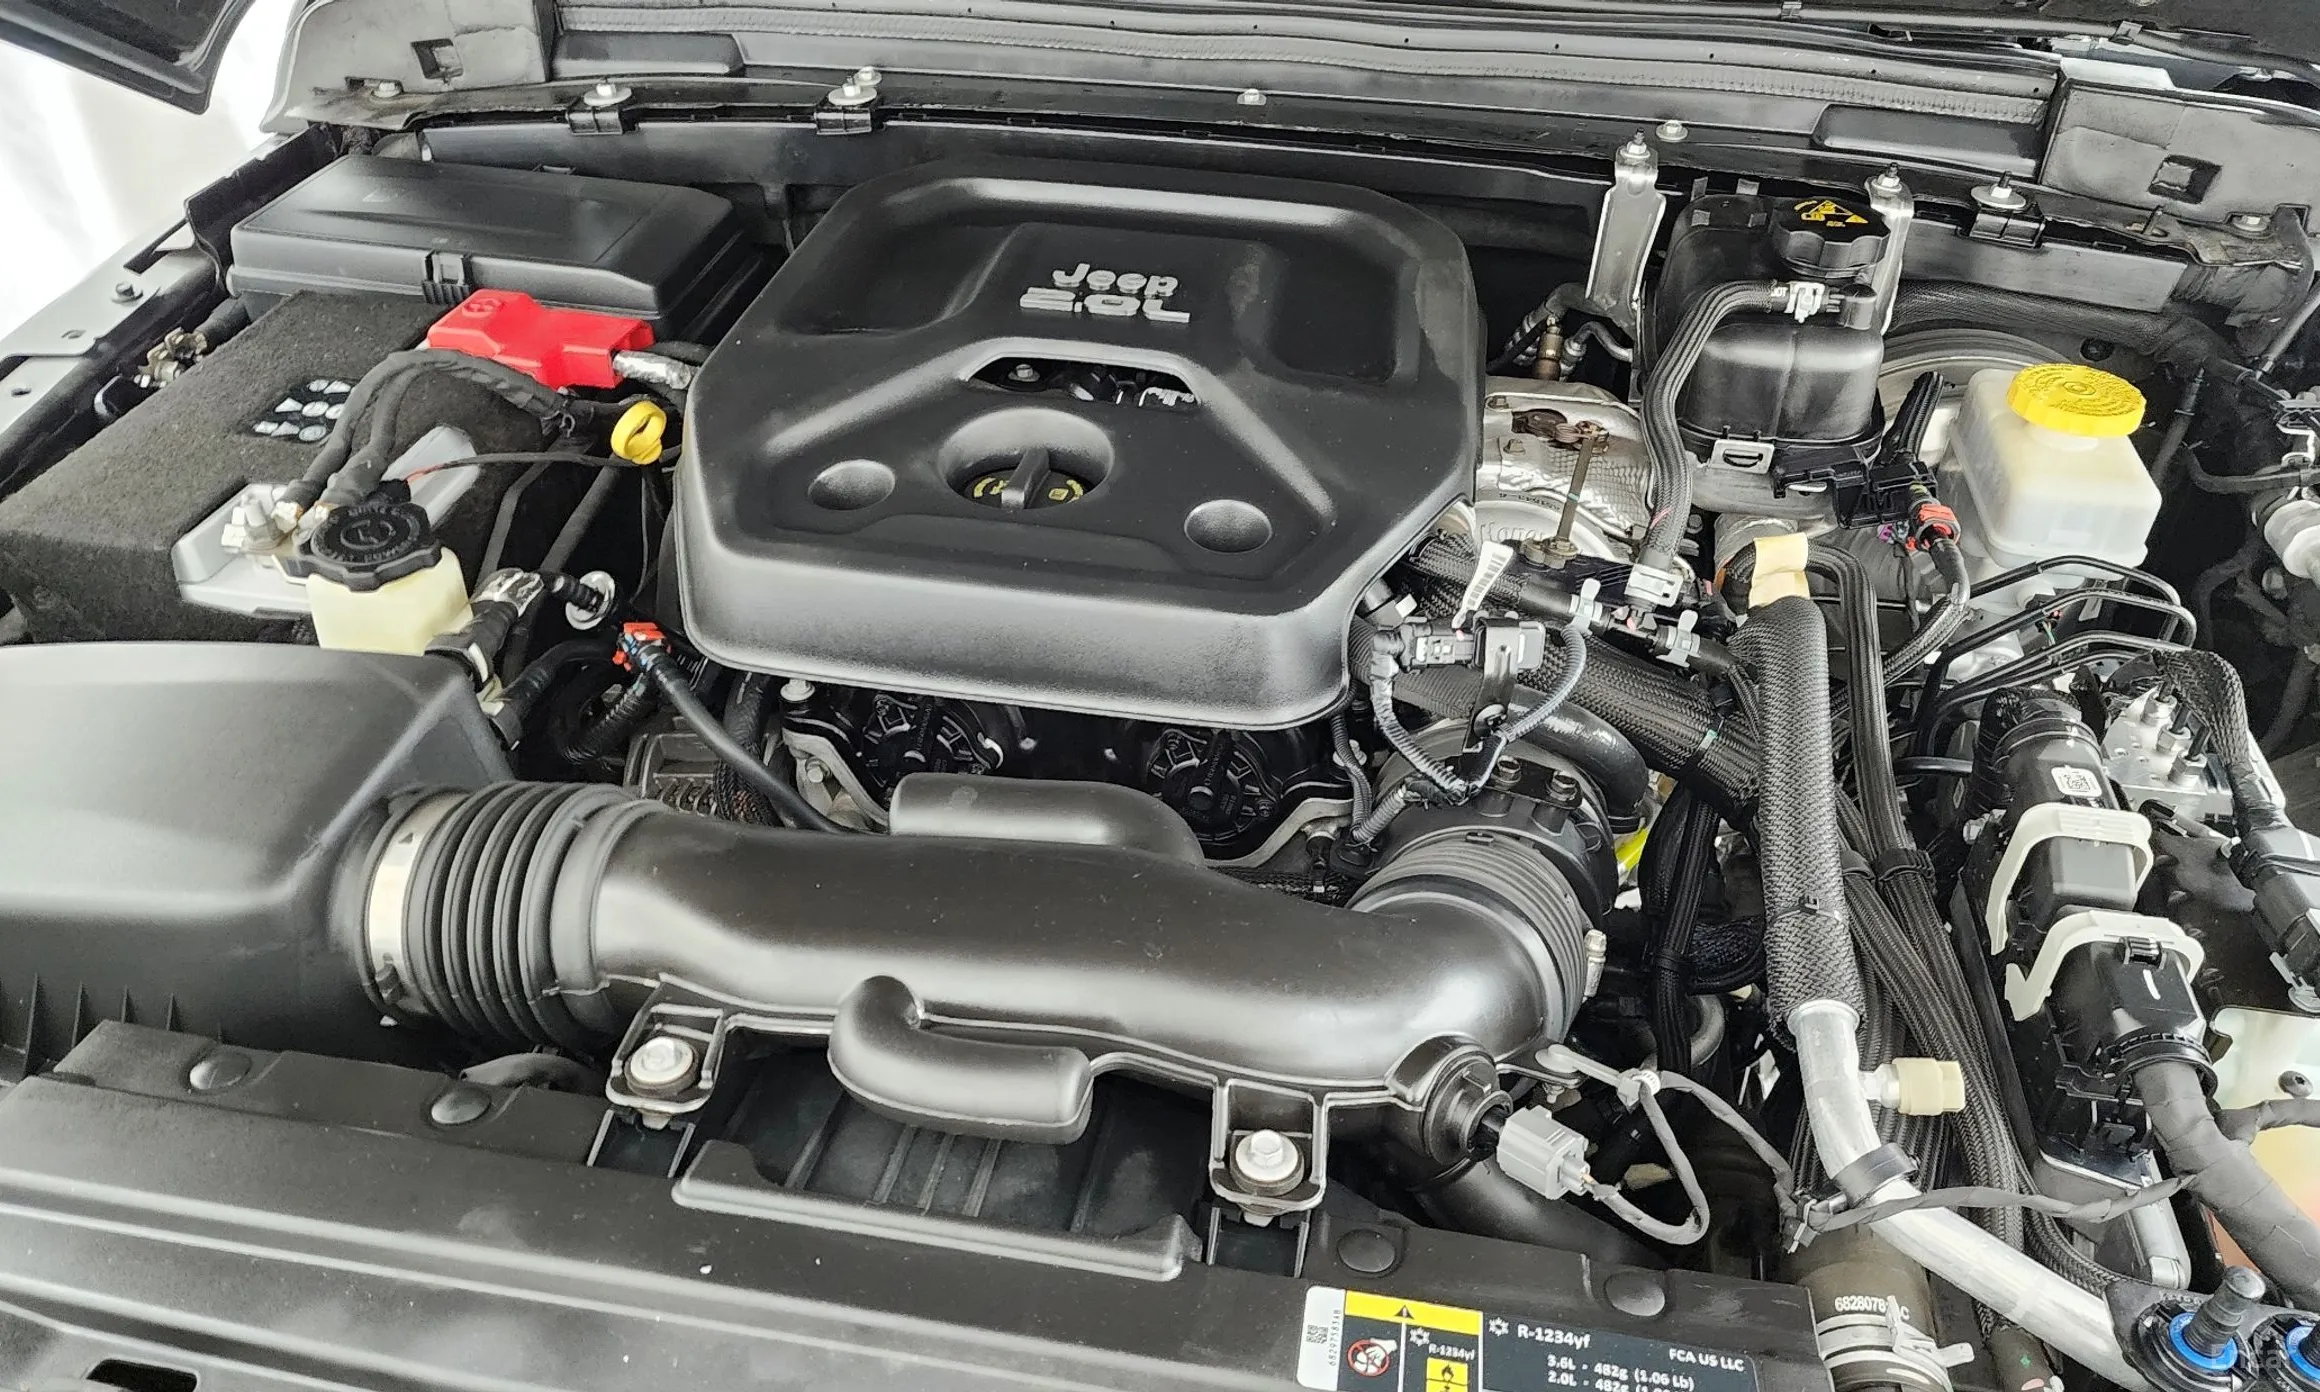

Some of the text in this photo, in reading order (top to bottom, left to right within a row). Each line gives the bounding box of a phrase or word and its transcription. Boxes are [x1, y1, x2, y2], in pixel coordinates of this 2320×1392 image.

[1052, 263, 1178, 298] Jeep
[1020, 287, 1190, 323] 2.0L
[1835, 1295, 1910, 1320] 6828078C
[1517, 1323, 1592, 1350] R-1234yf
[1428, 1343, 1476, 1362] R-1234yf
[1669, 1348, 1745, 1372] FCA US LLC
[1547, 1354, 1576, 1371] 3.6L
[1594, 1362, 1629, 1381] 482g
[1634, 1367, 1670, 1386] (1.06
[1672, 1374, 1695, 1392] Lb)
[1547, 1370, 1577, 1387] 2.0L
